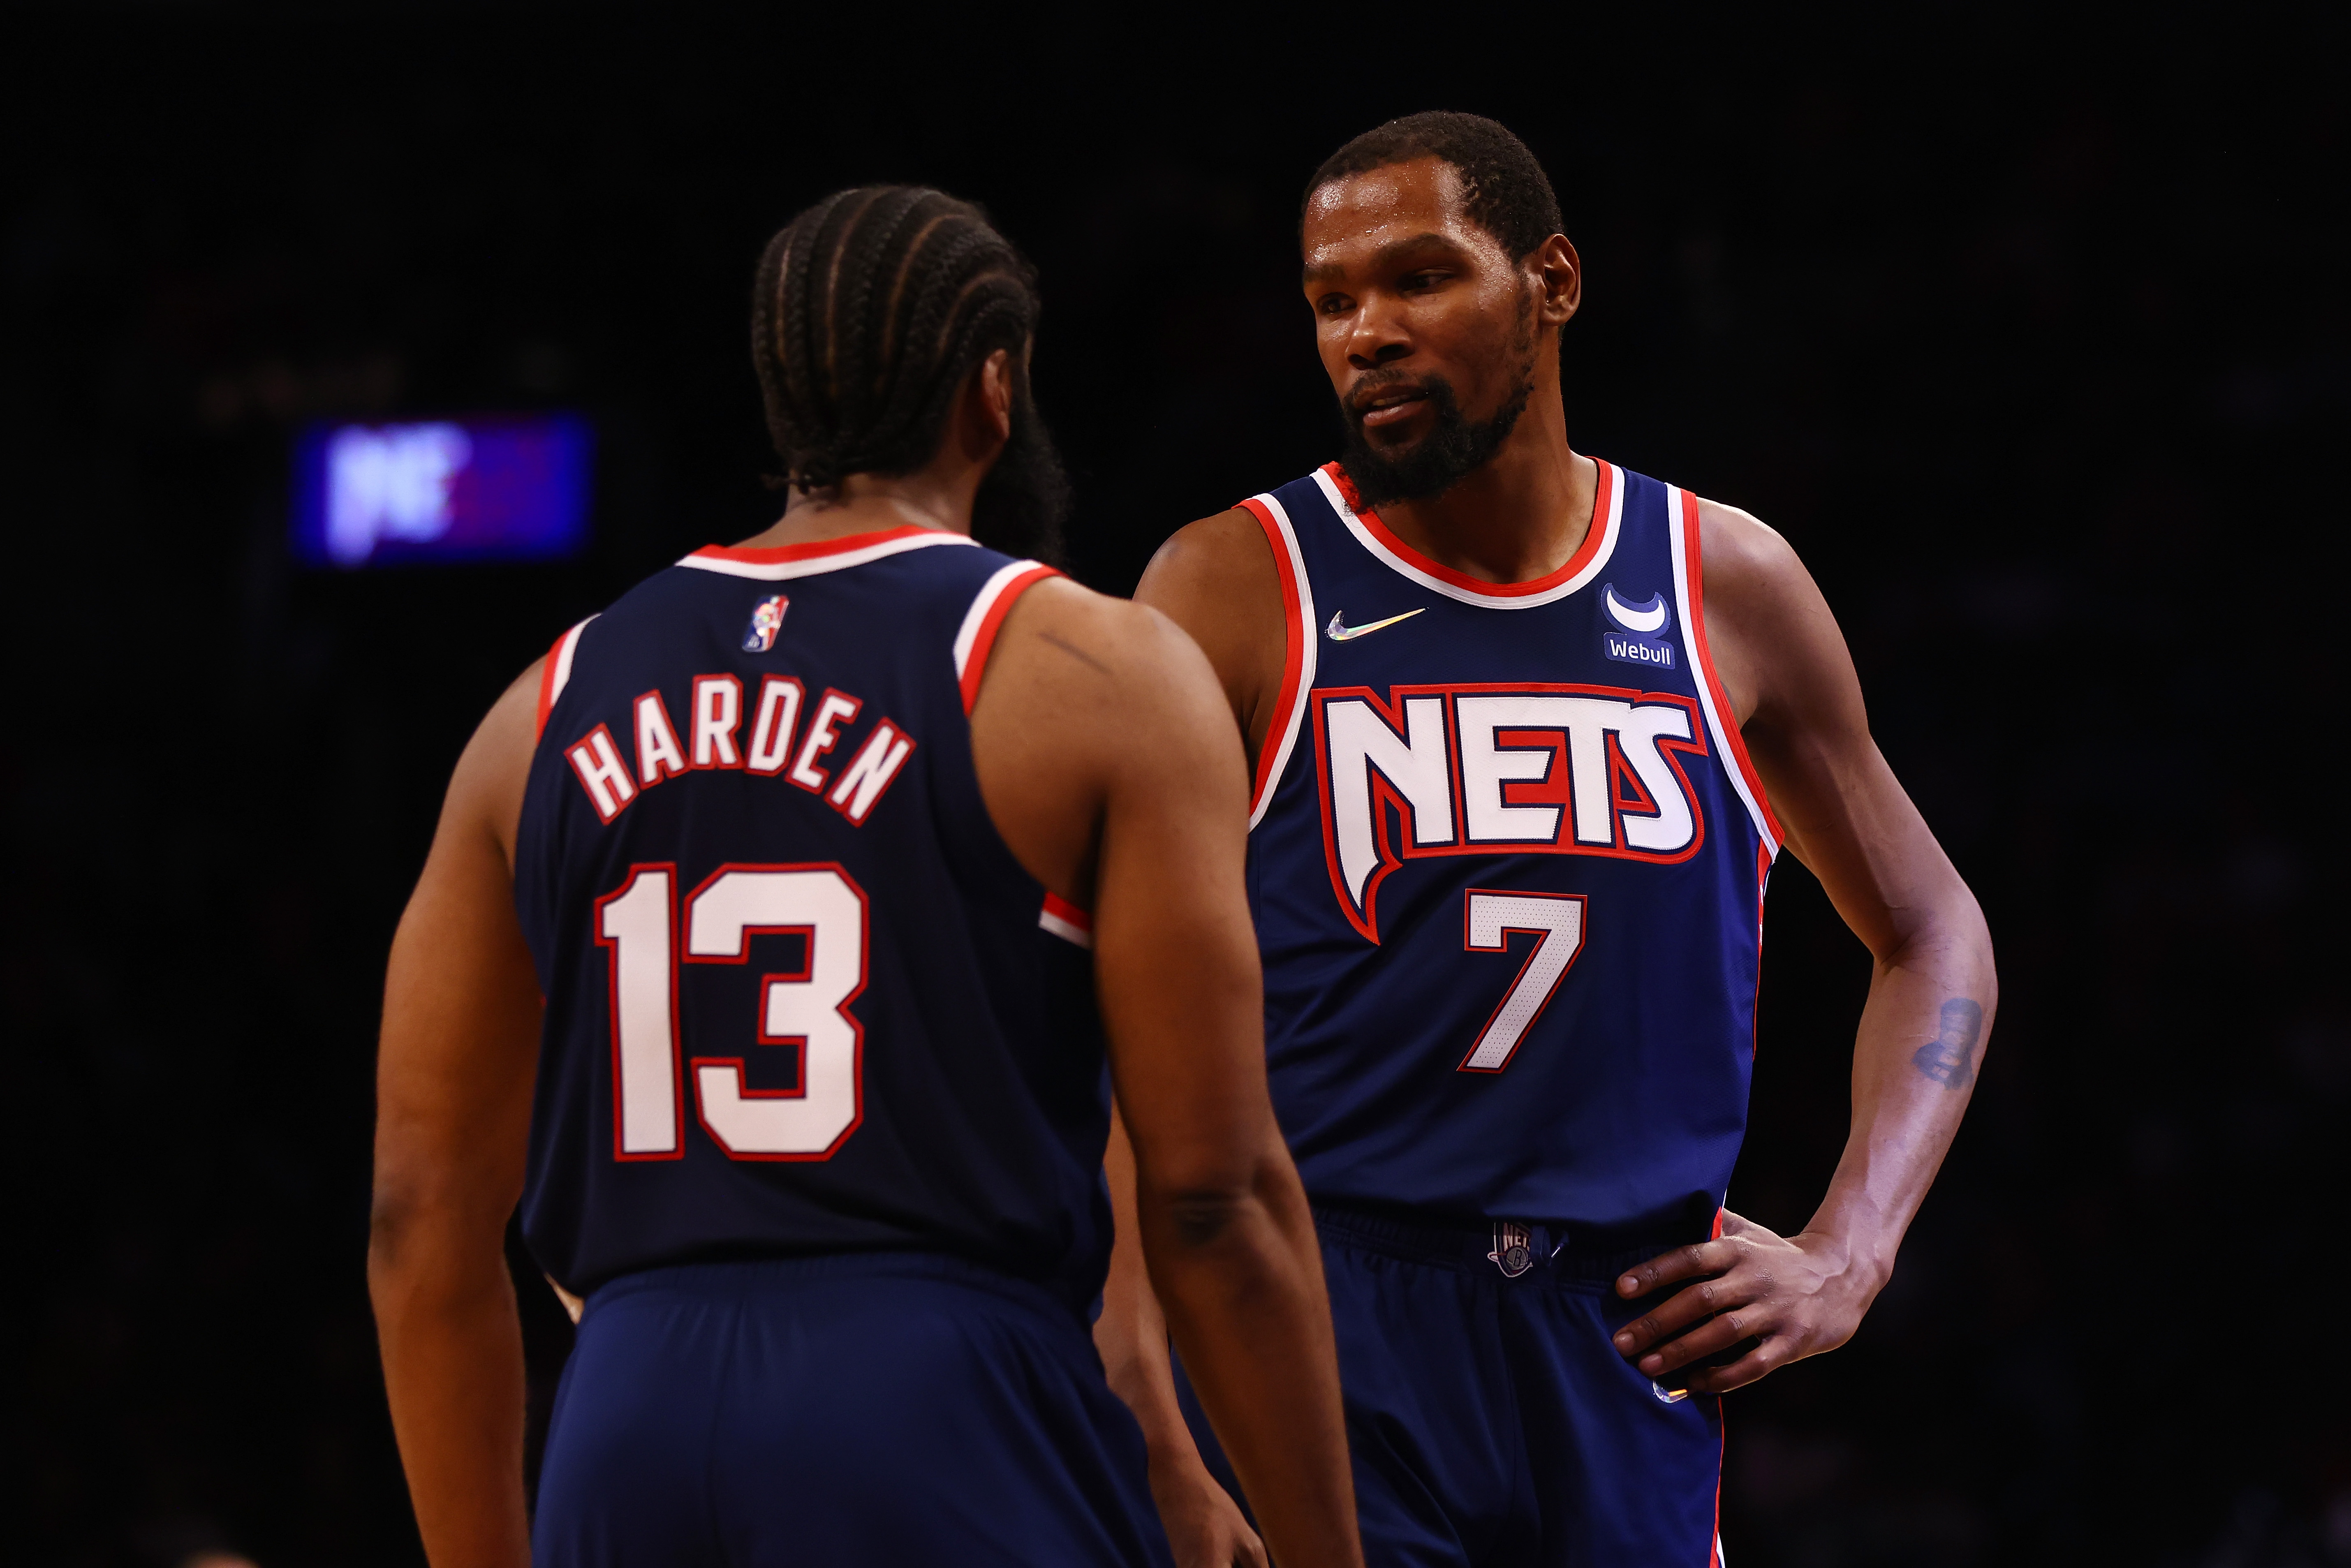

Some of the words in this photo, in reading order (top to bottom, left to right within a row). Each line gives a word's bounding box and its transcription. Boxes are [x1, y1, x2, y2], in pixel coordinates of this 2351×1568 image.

[1609, 638, 1671, 665] Webull
[563, 672, 917, 828] HARDEN
[1311, 682, 1709, 946] NETS
[594, 861, 870, 1162] 13
[1456, 888, 1587, 1074] 7
